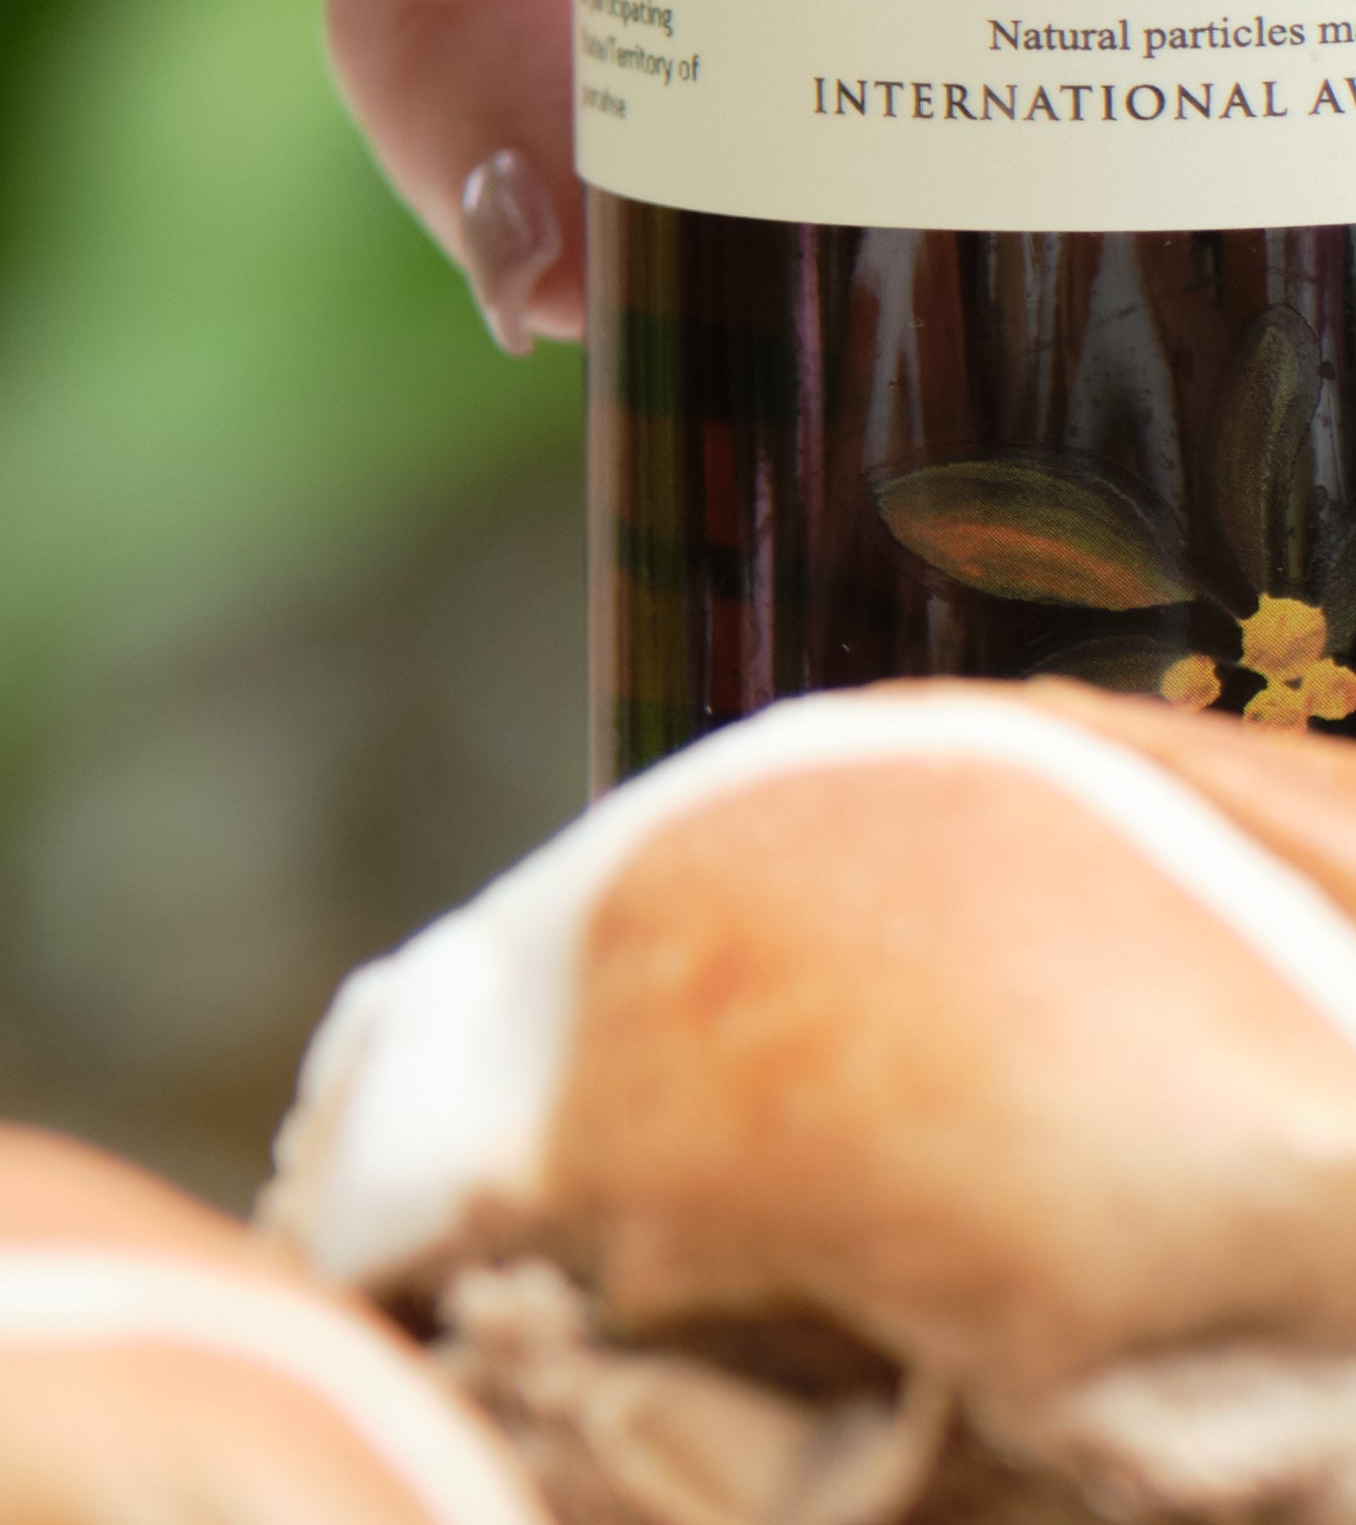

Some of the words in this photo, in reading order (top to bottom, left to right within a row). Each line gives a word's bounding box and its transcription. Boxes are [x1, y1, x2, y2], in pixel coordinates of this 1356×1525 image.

[987, 19, 1131, 51] Natural
[1143, 15, 1306, 60] particles
[678, 54, 700, 81] of
[814, 77, 1288, 122] INTERNATIONAL
